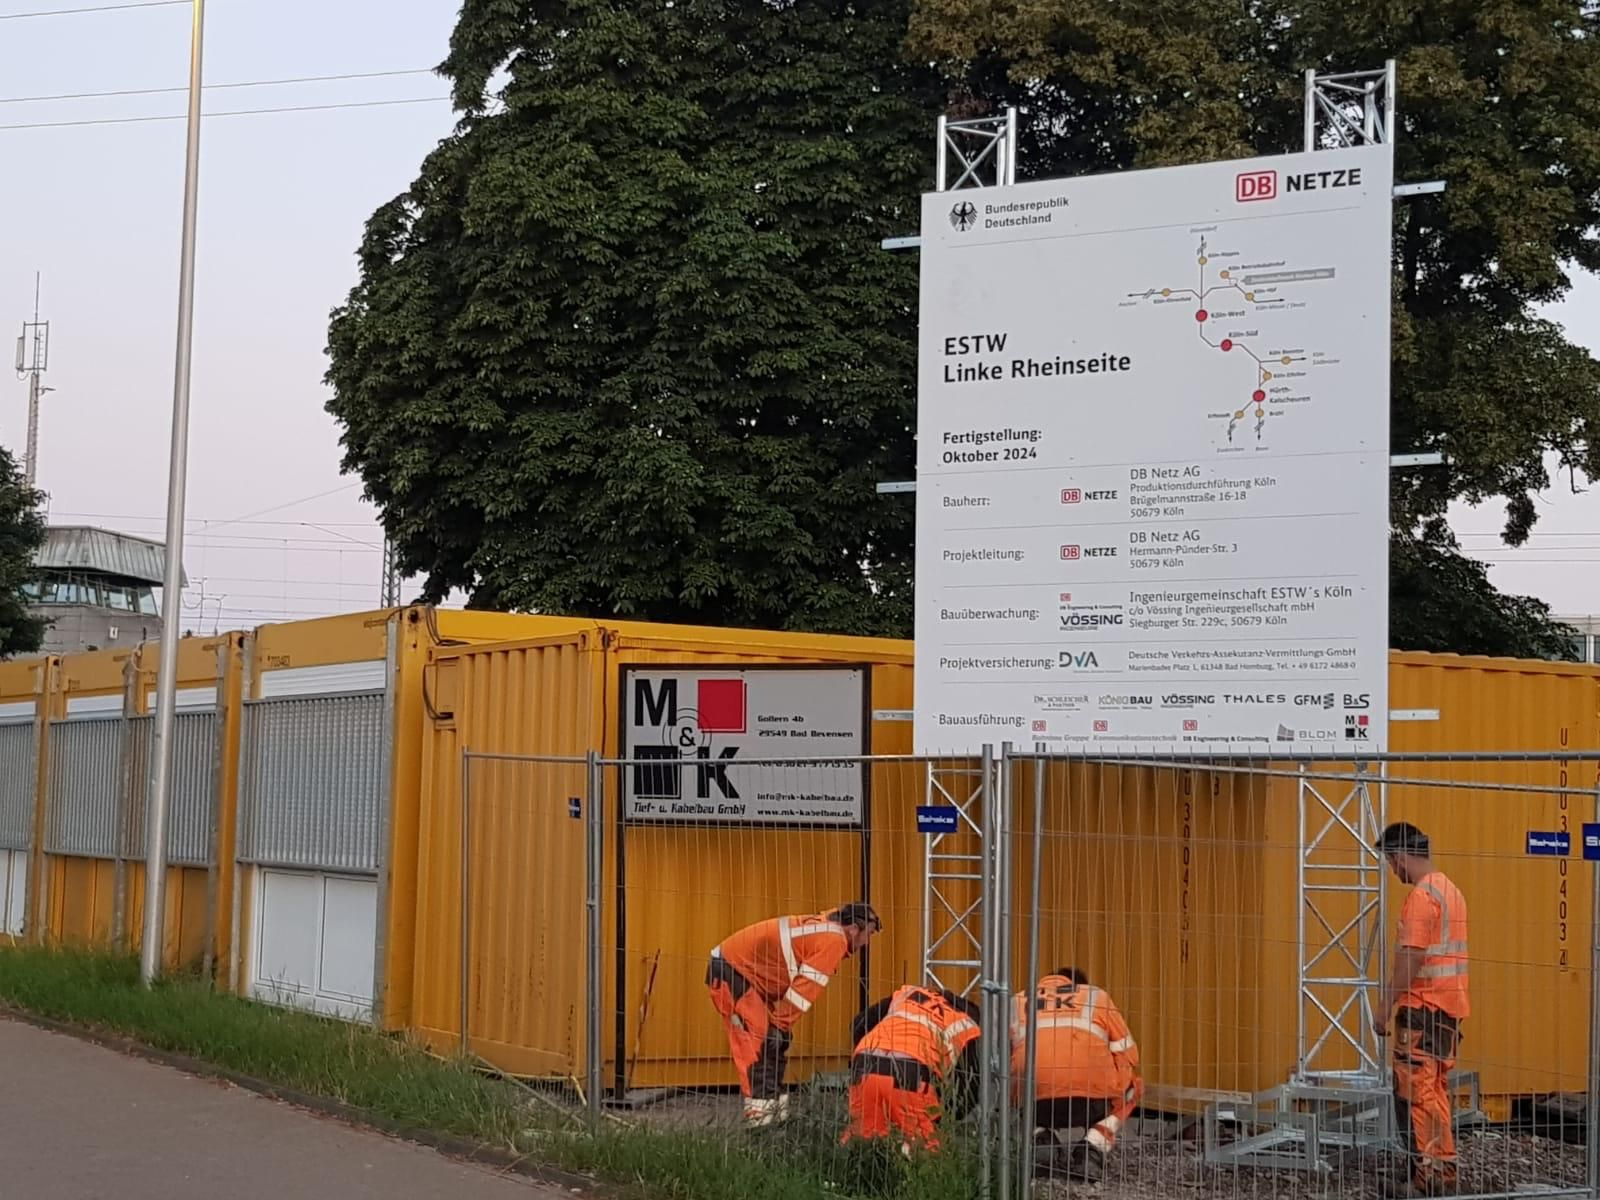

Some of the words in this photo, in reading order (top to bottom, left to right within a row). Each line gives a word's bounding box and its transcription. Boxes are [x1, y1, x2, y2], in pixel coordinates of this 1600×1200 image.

[1239, 174, 1274, 199] DB
[1286, 168, 1361, 192] NETZE
[985, 197, 1069, 214] Bundesrepublik
[985, 213, 1051, 229] Deutschland
[945, 333, 1007, 355] ESTW
[944, 362, 1003, 383] Linke
[1011, 352, 1131, 378] Rheinseite
[943, 428, 1042, 445] Fertigstellung:
[943, 449, 999, 464] Oktober
[1003, 447, 1037, 460] 2024
[1130, 467, 1147, 480] DB
[1151, 466, 1179, 478] Netz
[1183, 465, 1200, 477] AG
[1130, 478, 1251, 492] Produktionsdurchführung
[1254, 476, 1276, 487] Köln
[943, 496, 990, 507] Bauherr:
[1062, 490, 1080, 503] DB
[1084, 490, 1118, 500] NETZE
[1130, 492, 1216, 506] Brügelmannstraße
[1220, 491, 1246, 501] 16-18
[1130, 508, 1160, 518] 50679
[1163, 506, 1184, 516] Köln
[1130, 532, 1147, 543] DB
[1151, 531, 1179, 542] Netz
[1183, 529, 1200, 541] AG
[943, 548, 1025, 563] Projektleitung:
[1062, 546, 1079, 559] DB
[1084, 547, 1117, 556] NETZE
[1130, 543, 1229, 556] Hermann-Pünder-Str.
[1232, 543, 1238, 553] 3
[1130, 558, 1160, 568] 50679
[1162, 556, 1184, 567] Köln
[1130, 587, 1267, 605] Ingenieurgemeinschaft
[1324, 585, 1352, 598] Köln
[940, 608, 1040, 621] Bauüberwachung:
[1129, 606, 1144, 616] c/o
[1146, 605, 1182, 616] Vössing
[1185, 602, 1288, 616] Ingenieurgesellschaft
[1291, 602, 1315, 612] mbH
[1060, 612, 1123, 626] VÖSSING
[1129, 618, 1179, 629] Siegburger
[1182, 617, 1198, 627] Str.
[1231, 616, 1262, 626] 50679
[1265, 615, 1288, 625] Köln
[940, 656, 1055, 670] Projektversicherung:
[1059, 651, 1098, 668] DVA
[1128, 650, 1169, 659] Deutsche
[1162, 694, 1215, 704] VÖSSING
[1223, 694, 1286, 703] THALES
[1294, 695, 1321, 705] GFM
[939, 713, 1026, 727] Bauausführung:
[1345, 715, 1355, 725] M
[1359, 728, 1367, 738] K
[634, 679, 677, 726] M
[680, 727, 696, 747] &
[697, 747, 740, 798] K
